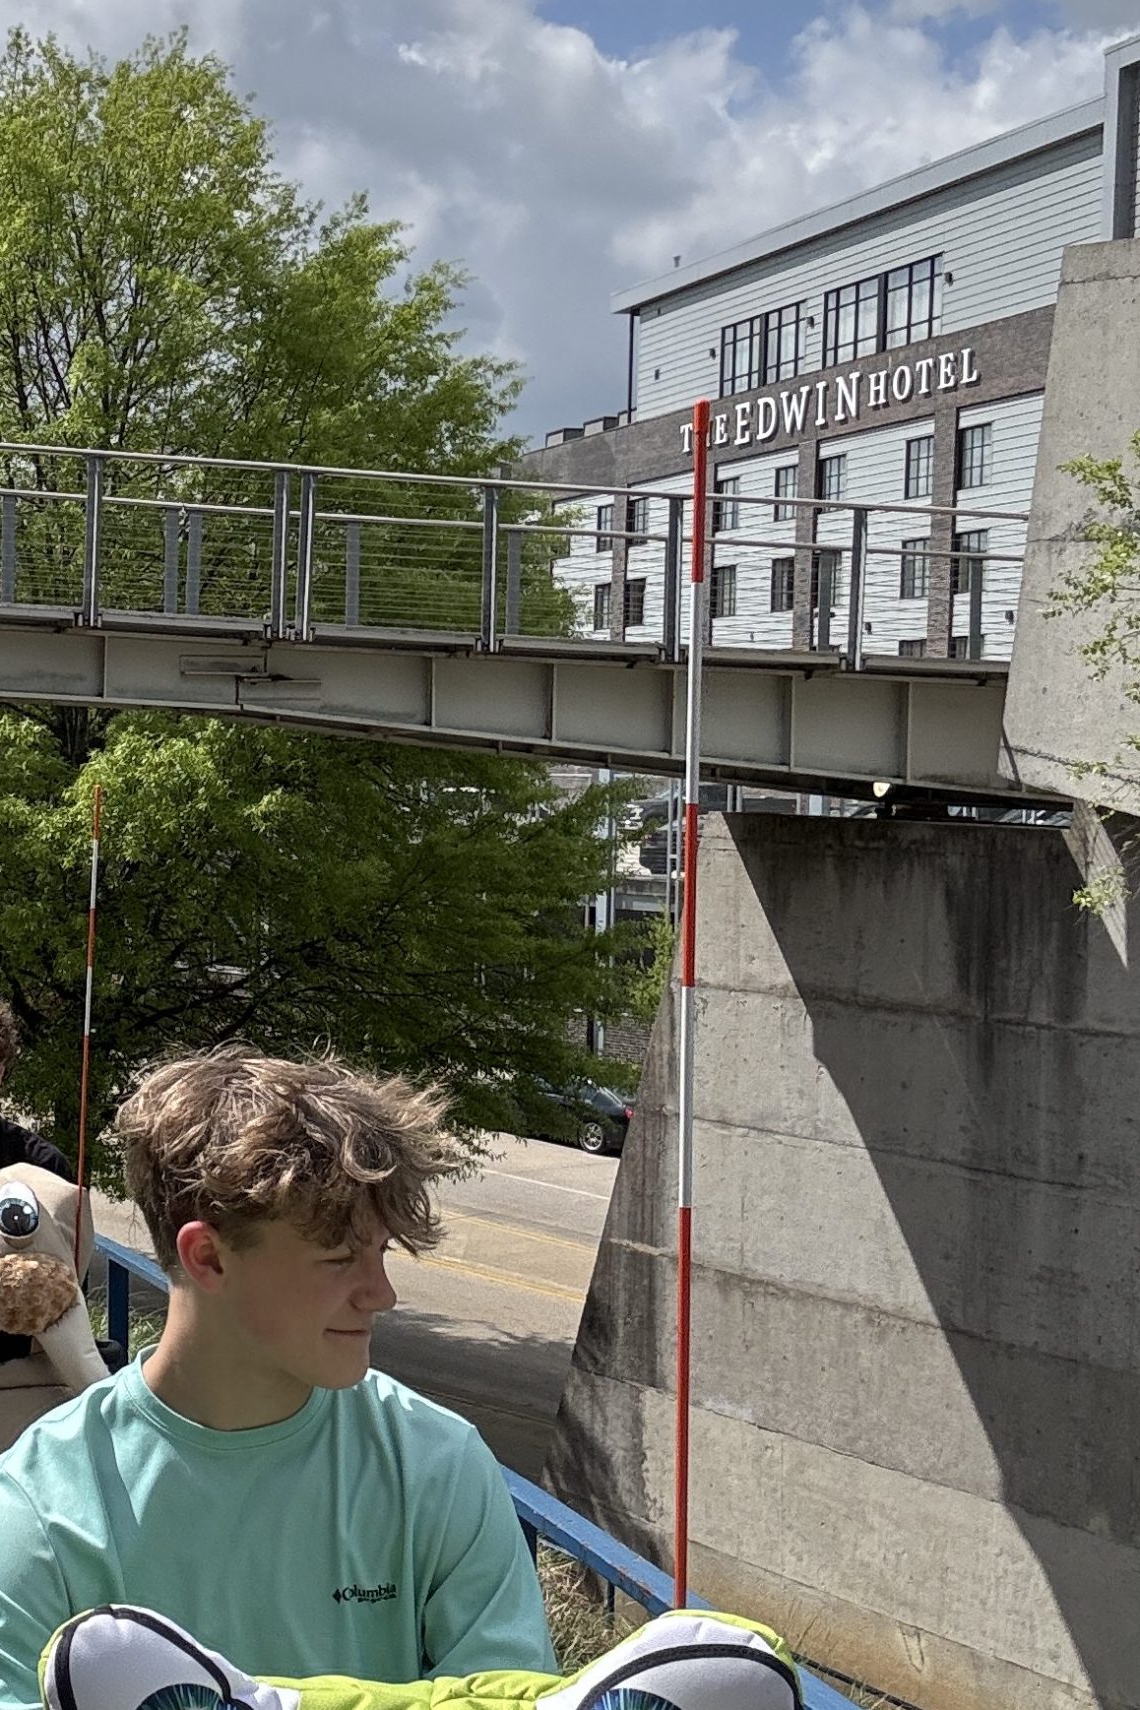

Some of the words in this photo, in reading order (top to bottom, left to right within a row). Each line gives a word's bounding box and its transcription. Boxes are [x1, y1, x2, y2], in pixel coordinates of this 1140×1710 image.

[734, 371, 862, 445] EDWIN
[867, 348, 978, 407] HOTEL
[342, 1583, 397, 1601] Columbia
